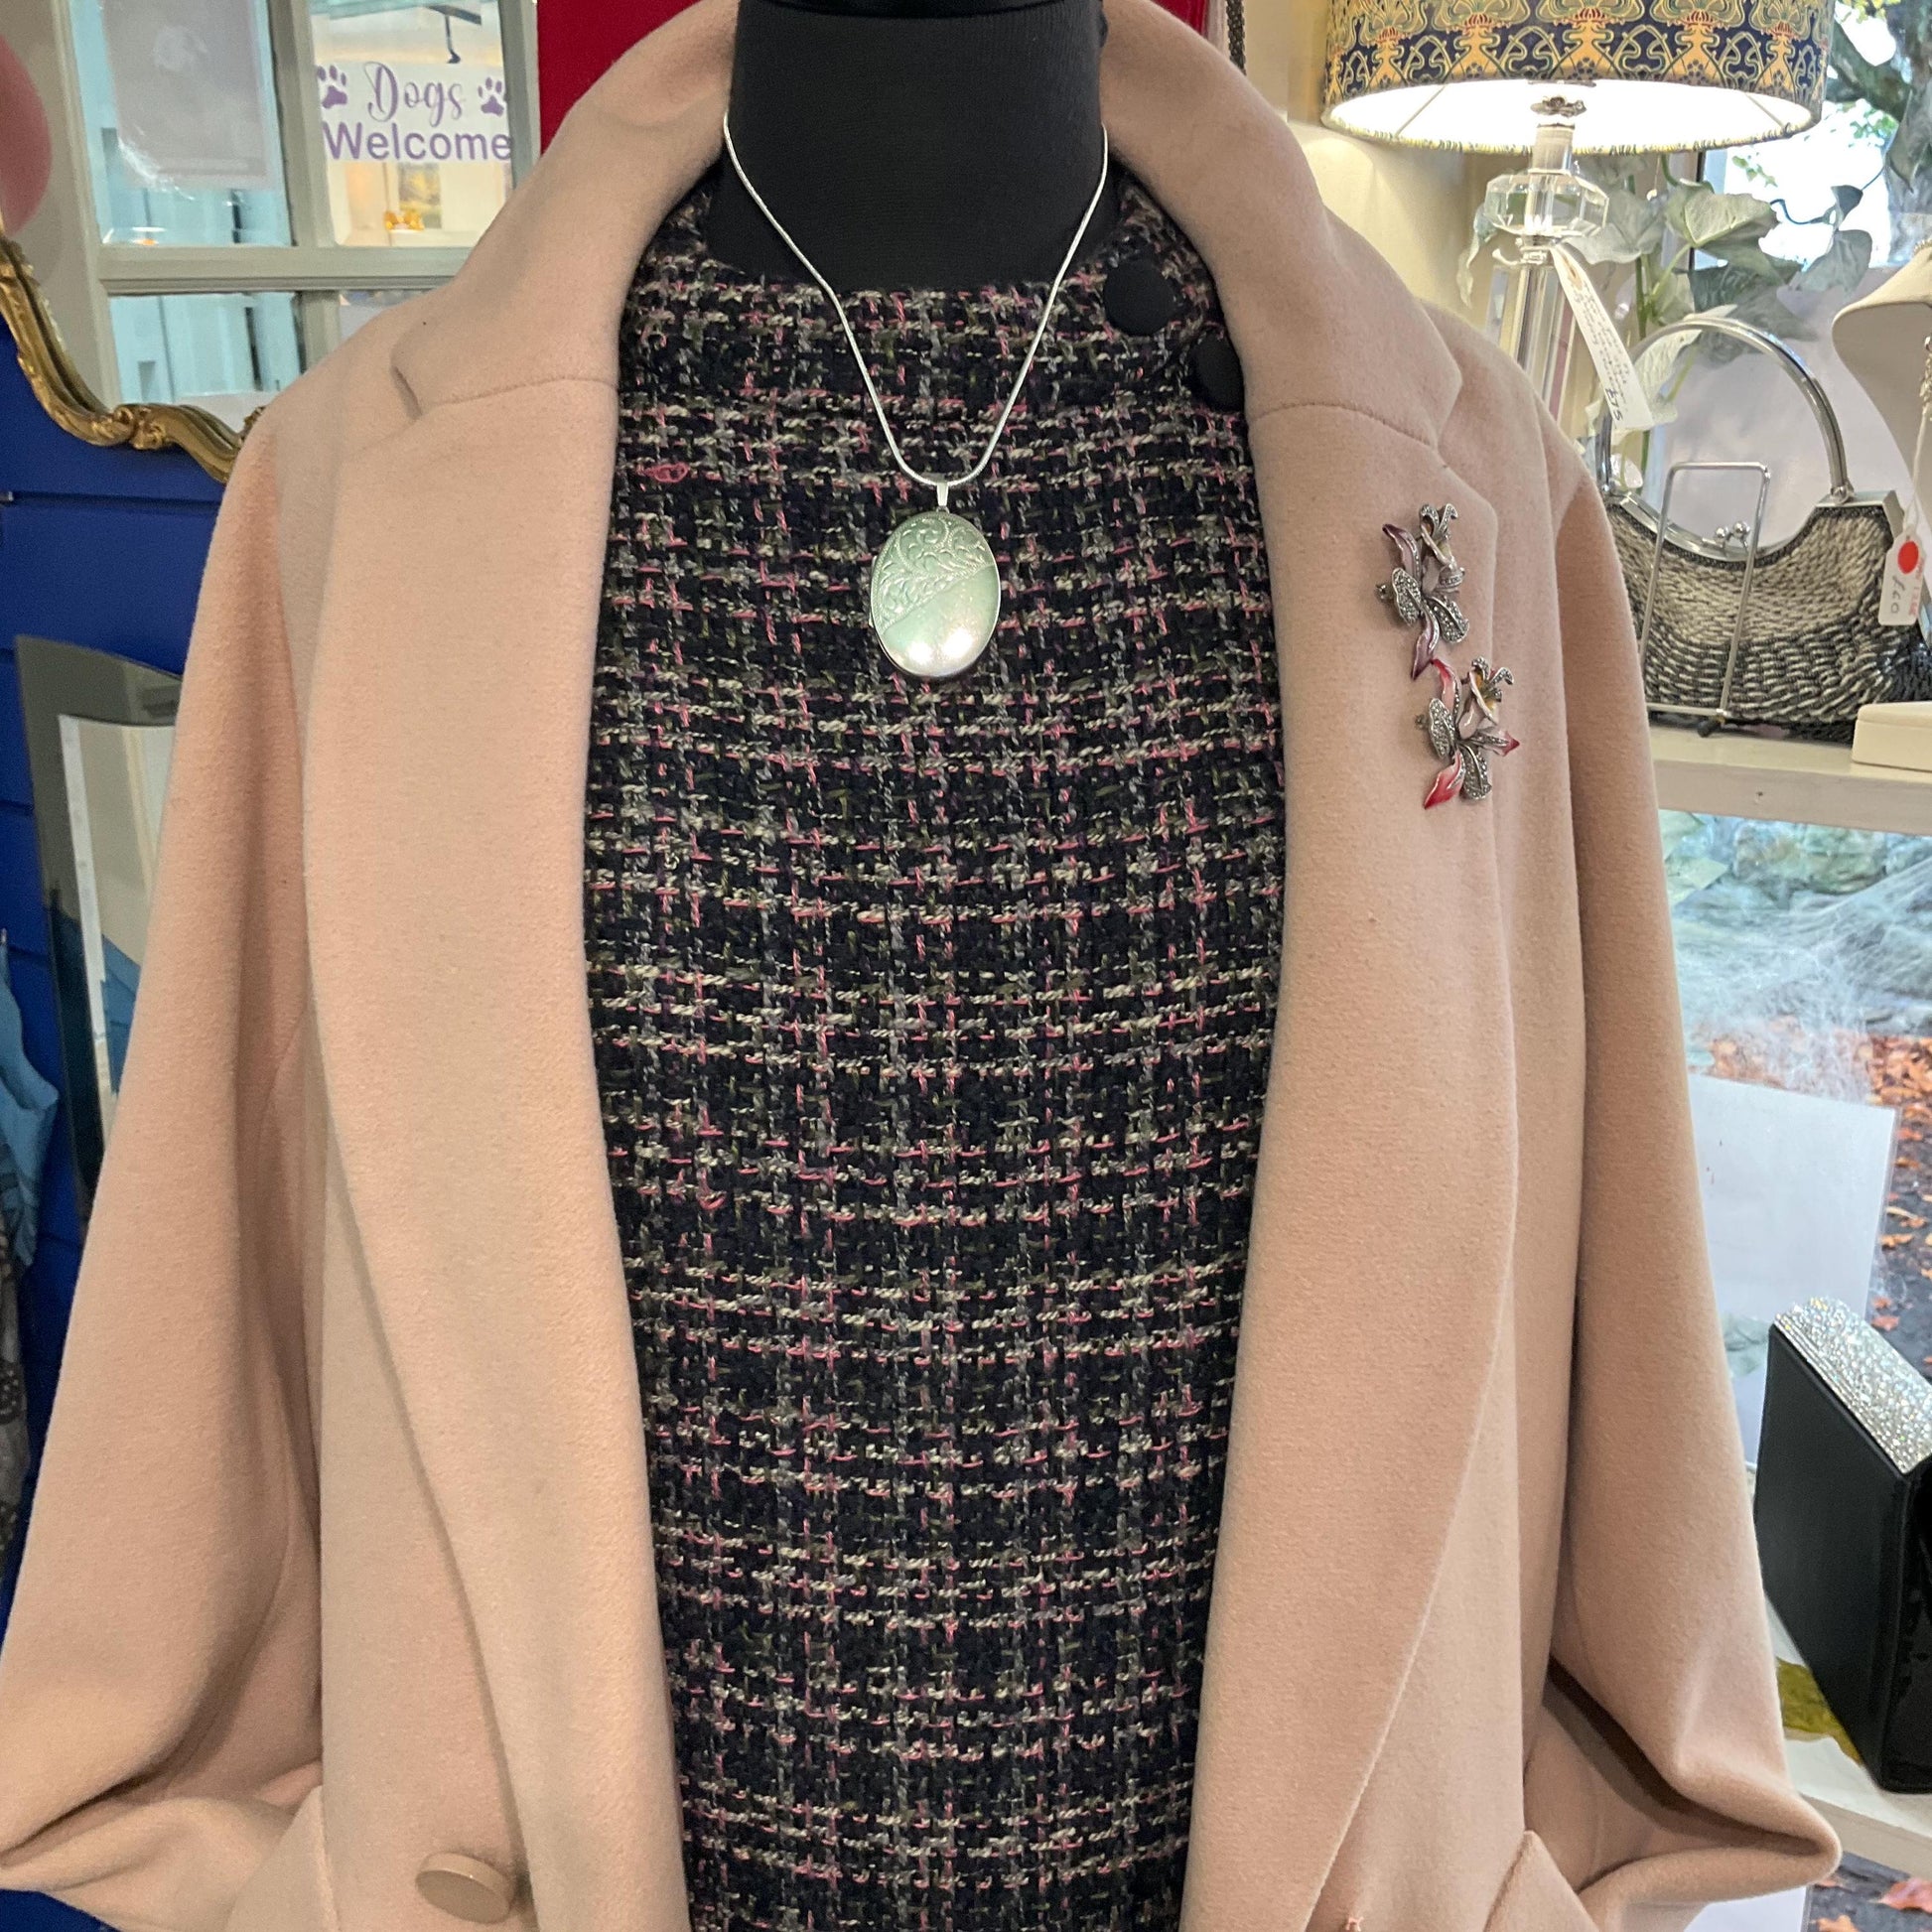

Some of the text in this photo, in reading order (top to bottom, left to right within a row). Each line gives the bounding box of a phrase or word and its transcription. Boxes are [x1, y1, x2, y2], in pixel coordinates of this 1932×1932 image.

[364, 62, 464, 127] Dogs
[323, 122, 511, 160] Welcome
[1605, 387, 1623, 422] £75
